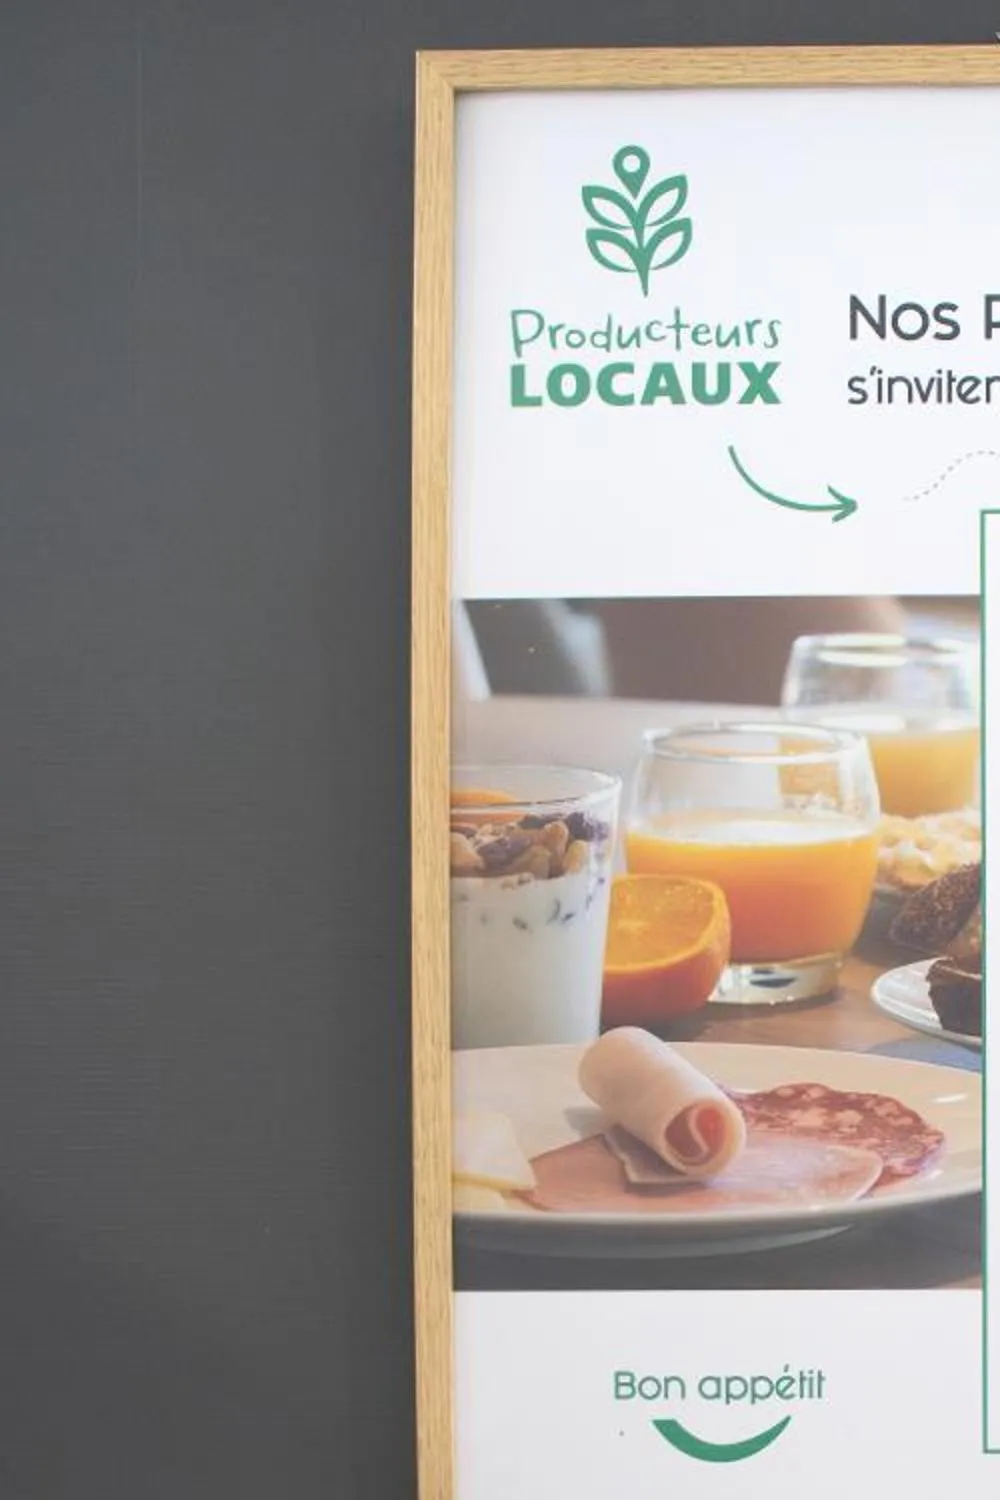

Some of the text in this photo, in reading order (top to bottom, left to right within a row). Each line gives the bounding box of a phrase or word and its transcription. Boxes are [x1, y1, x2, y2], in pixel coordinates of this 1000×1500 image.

[511, 307, 781, 358] Producteurs
[850, 294, 960, 341] Nos
[511, 362, 782, 407] LOCAUX
[614, 1364, 825, 1405] Bon appétit
